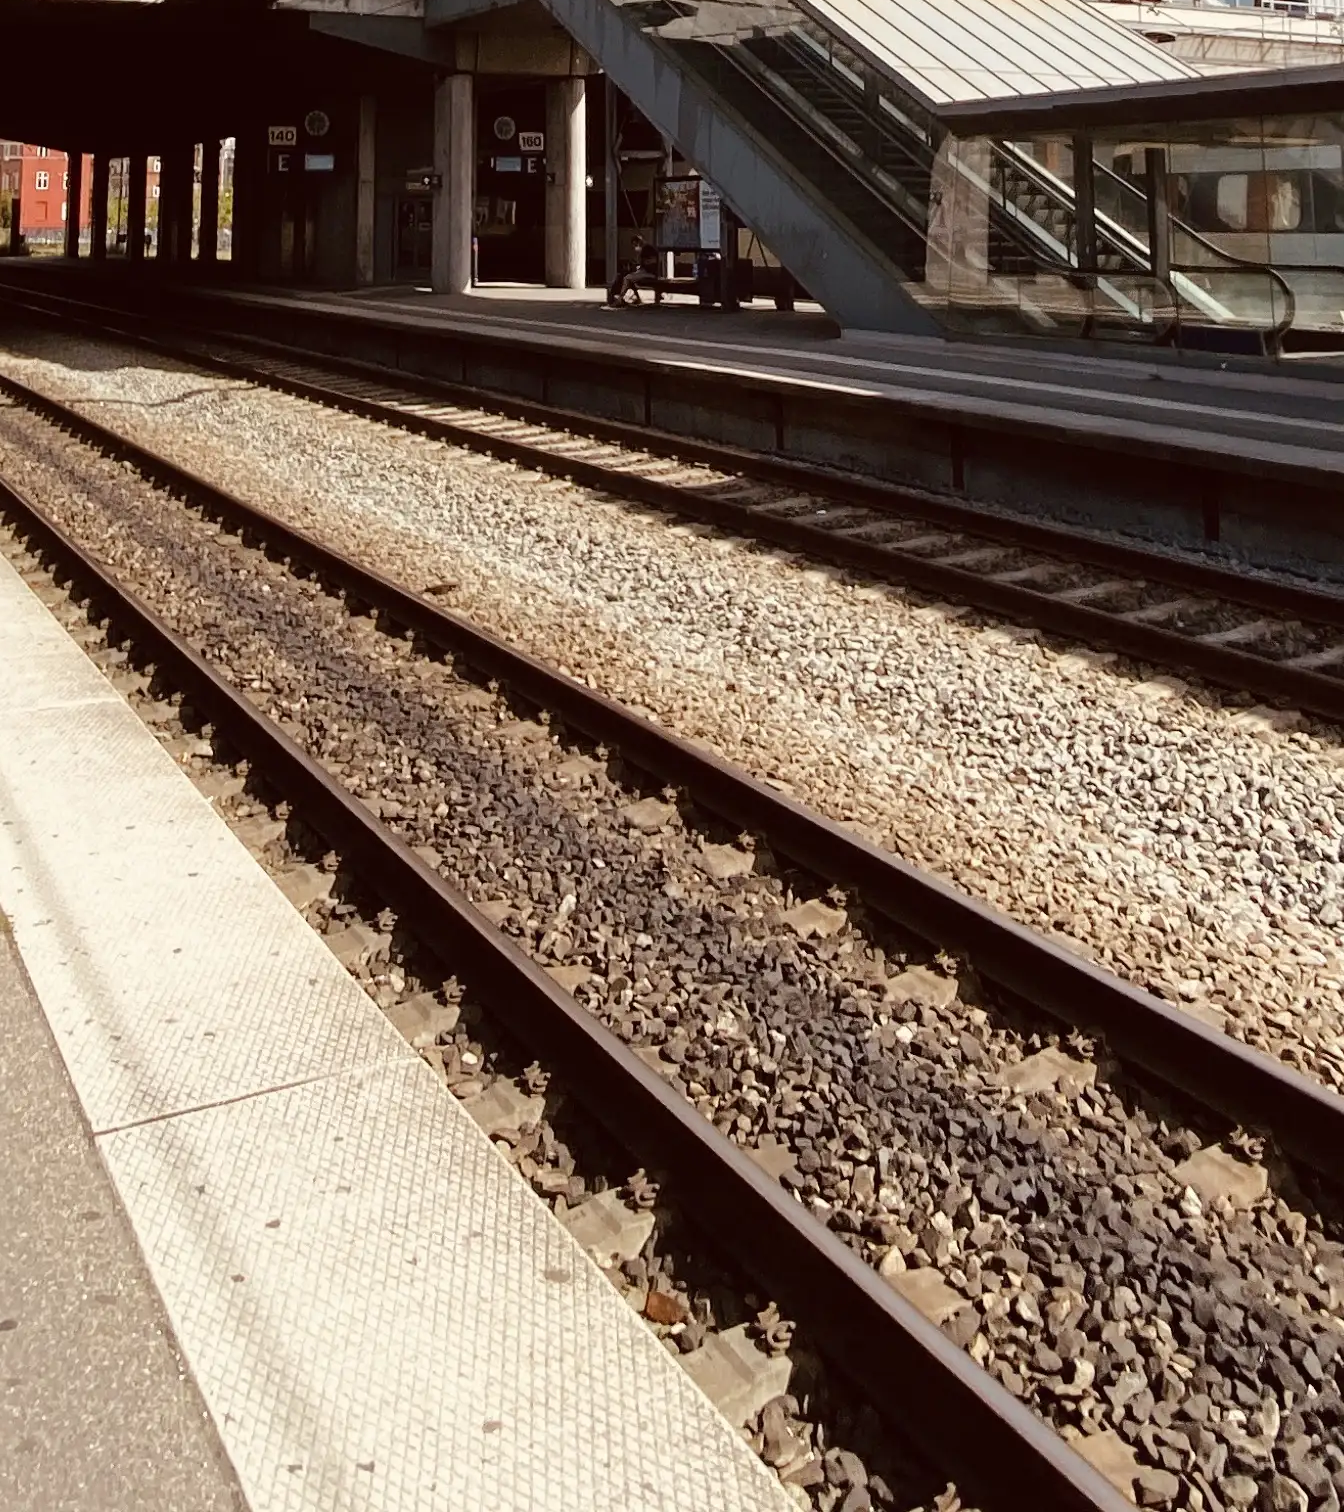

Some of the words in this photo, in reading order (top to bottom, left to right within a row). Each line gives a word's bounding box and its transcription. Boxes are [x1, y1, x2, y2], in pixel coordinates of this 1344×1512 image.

[269, 129, 295, 142] 140
[278, 154, 290, 171] E
[527, 157, 537, 173] E
